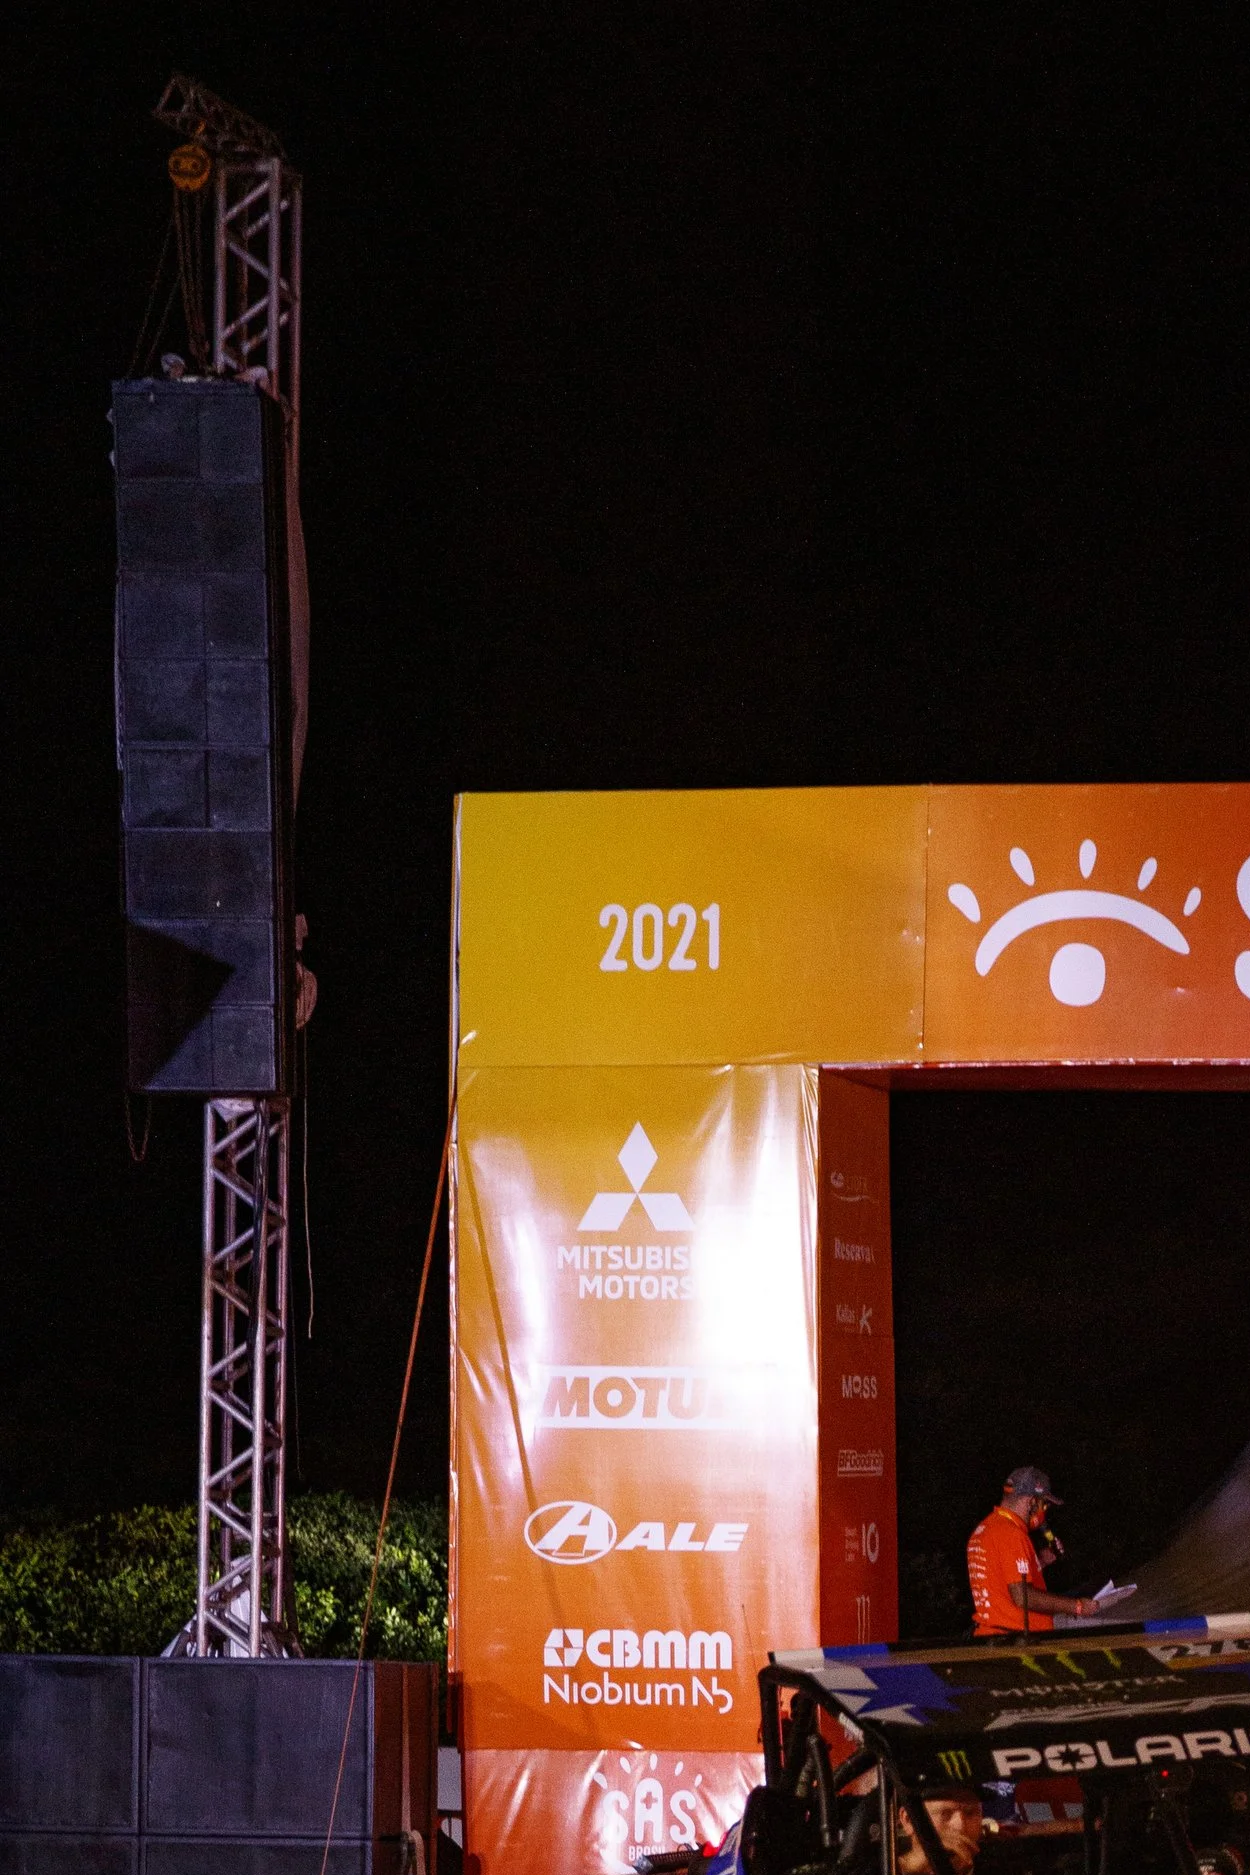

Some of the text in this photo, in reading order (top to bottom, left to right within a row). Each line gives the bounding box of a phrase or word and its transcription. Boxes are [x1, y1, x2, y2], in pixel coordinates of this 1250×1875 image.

[598, 902, 721, 972] 2021
[557, 1245, 700, 1271] MITSUBIS
[578, 1275, 696, 1300] MOTORS
[542, 1376, 726, 1419] MOTU
[614, 1521, 749, 1552] ALE
